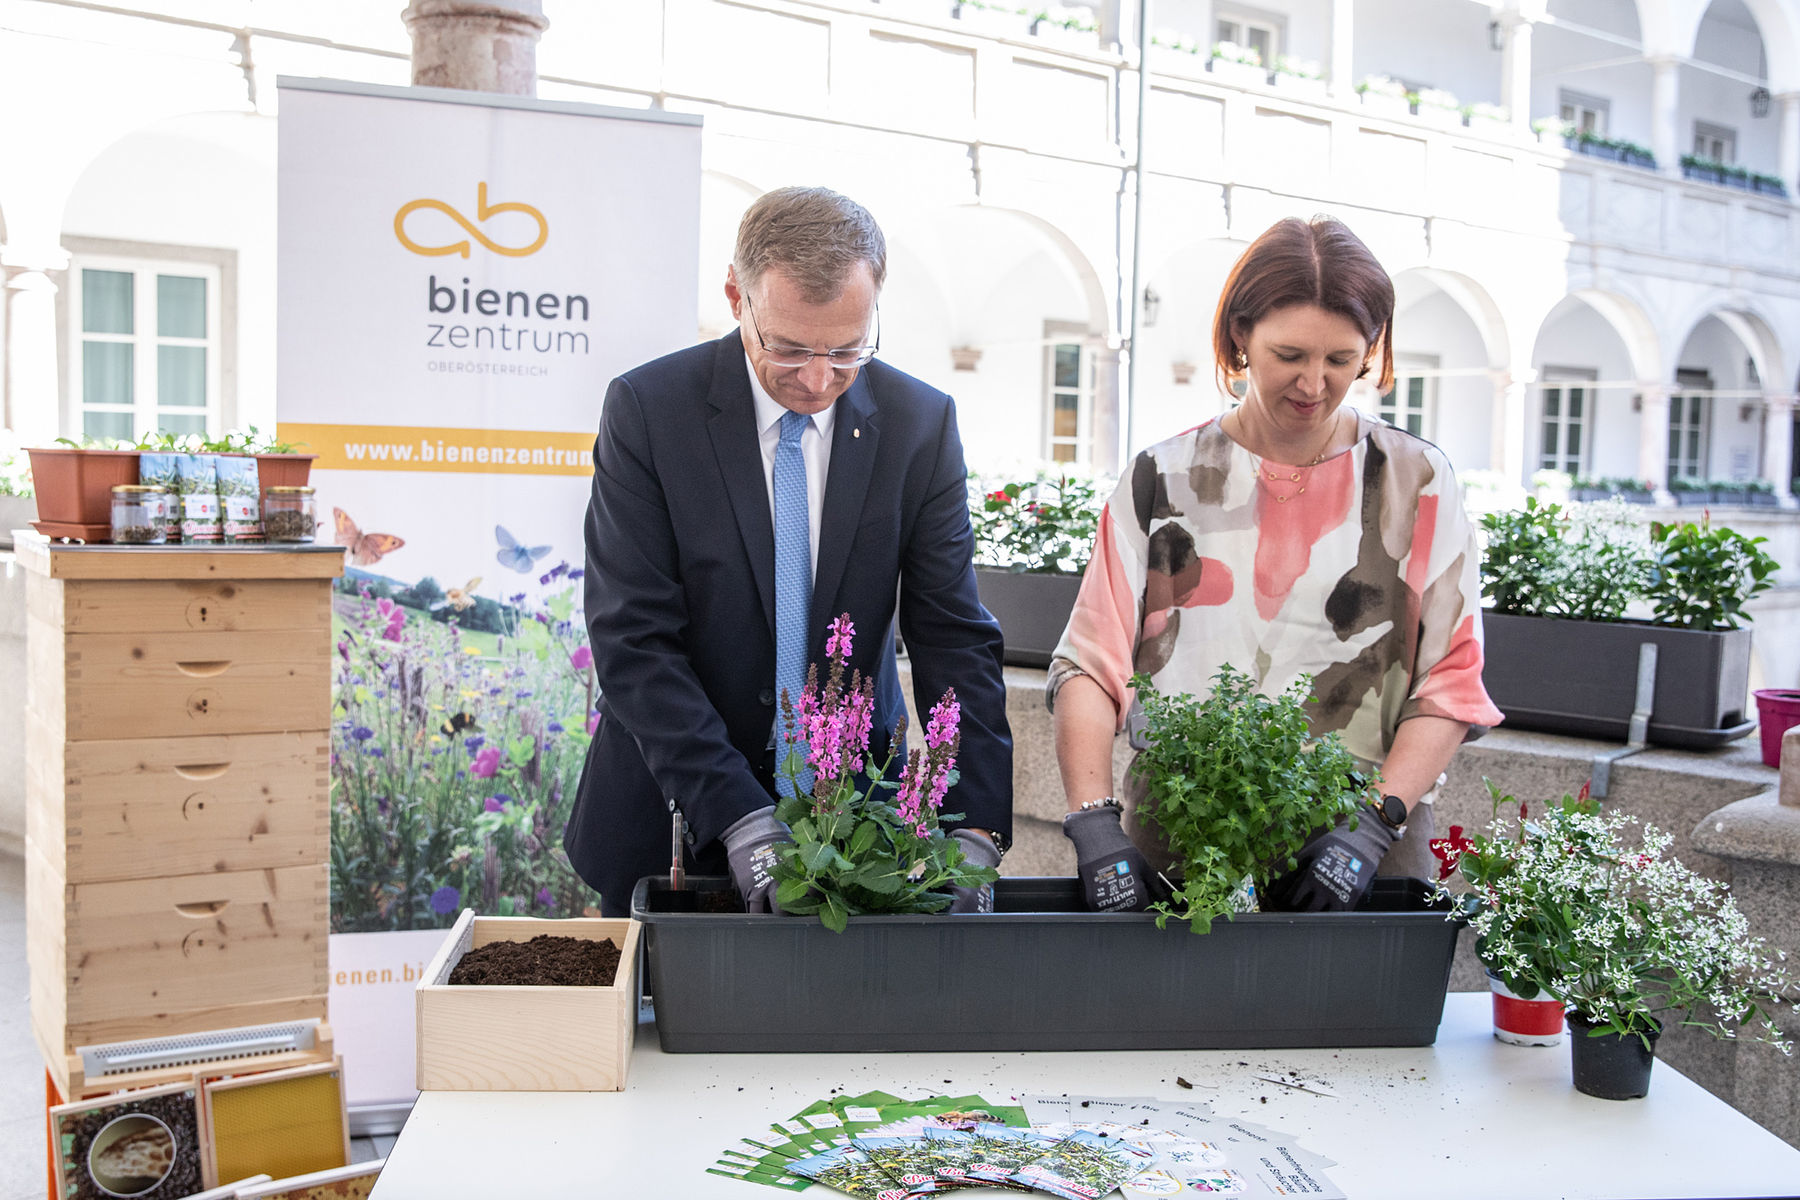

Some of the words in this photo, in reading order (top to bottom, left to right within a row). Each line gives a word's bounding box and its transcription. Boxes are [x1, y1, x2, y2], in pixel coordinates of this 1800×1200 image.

[428, 275, 589, 321] bienen
[427, 323, 590, 355] zentrum
[427, 361, 549, 376] OBERÖSTERREICH
[1113, 888, 1135, 902] MULTI
